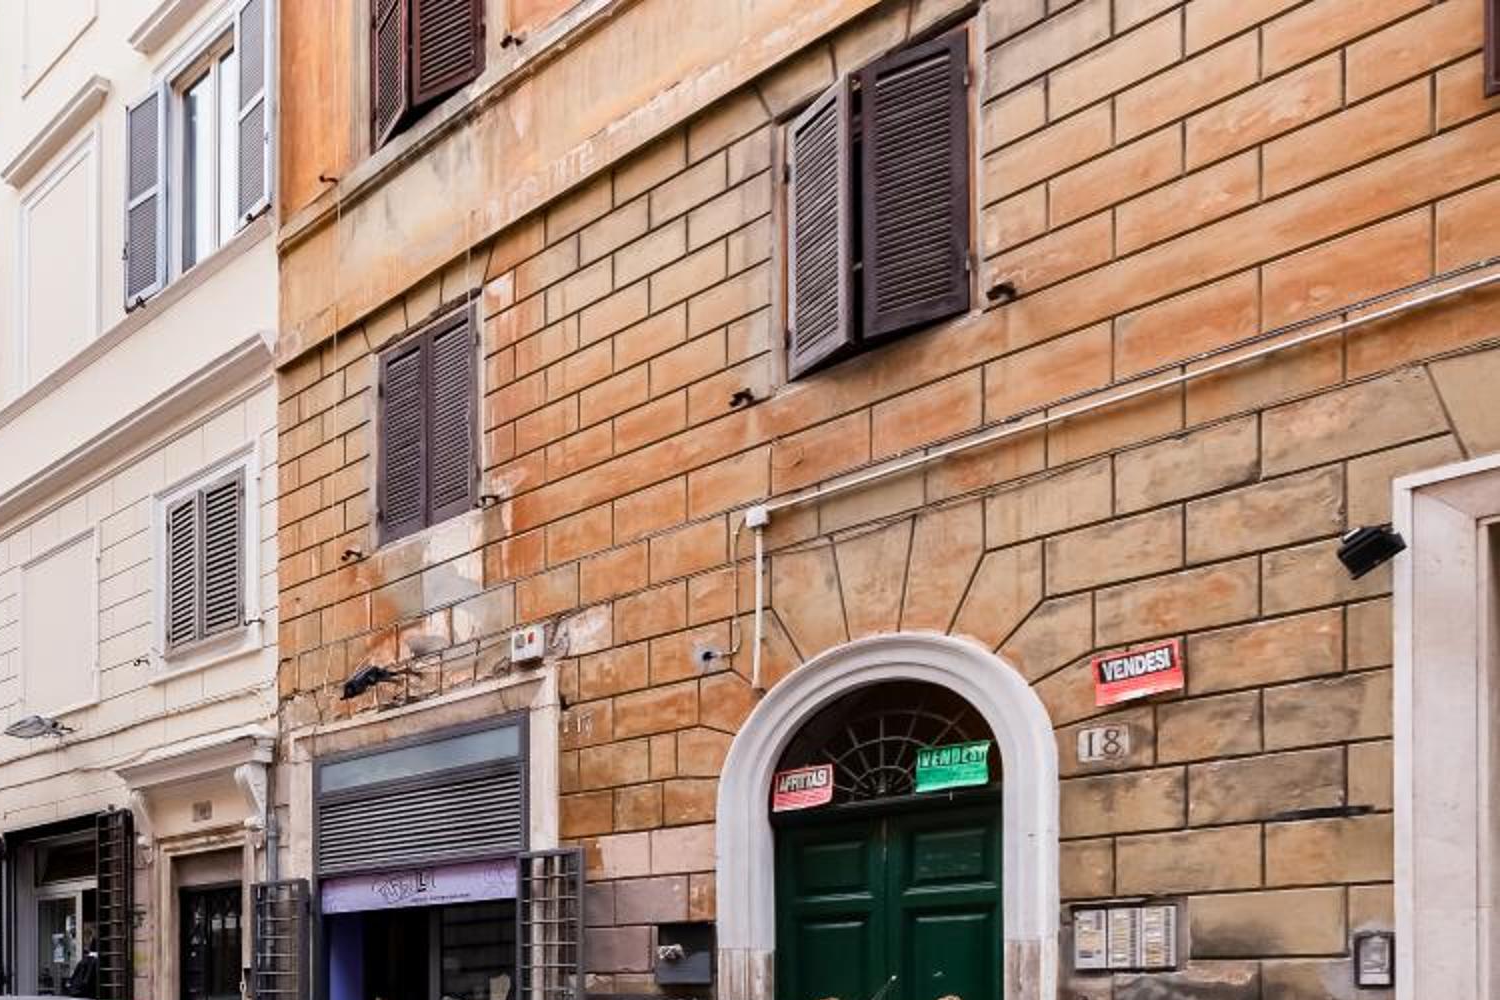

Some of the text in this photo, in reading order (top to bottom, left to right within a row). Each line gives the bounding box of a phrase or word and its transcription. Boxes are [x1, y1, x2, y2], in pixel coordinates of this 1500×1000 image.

[1101, 647, 1172, 681] VENDESI
[920, 746, 986, 768] VENDESI
[1087, 729, 1121, 757] 18
